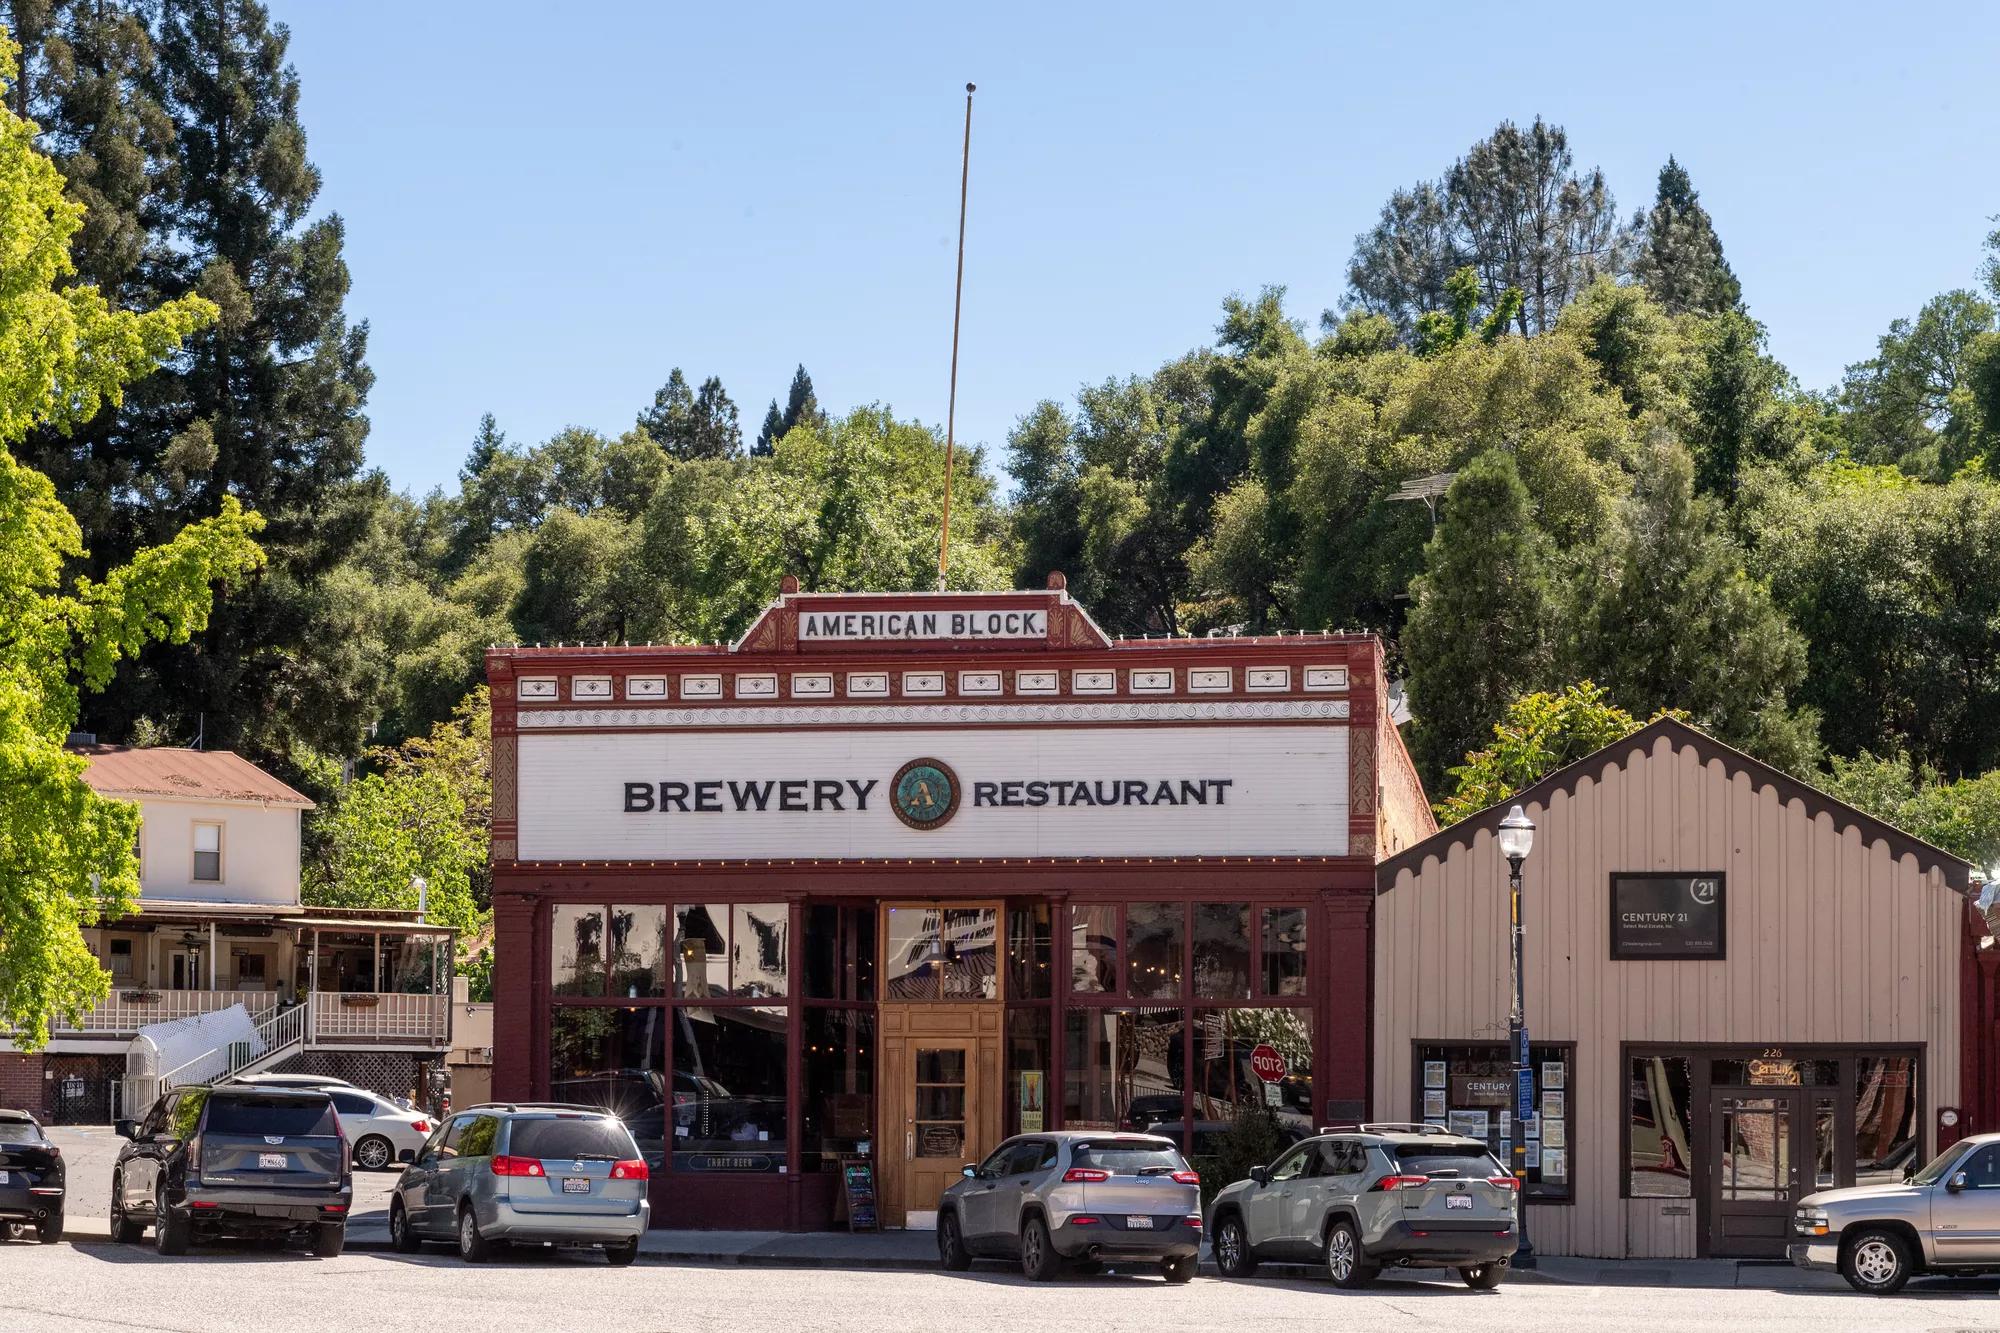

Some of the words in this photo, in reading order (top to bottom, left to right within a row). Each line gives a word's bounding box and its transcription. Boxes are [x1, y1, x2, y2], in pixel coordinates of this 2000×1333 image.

[806, 614, 936, 636] AMERICAN
[951, 612, 1046, 635] BLOCK.
[623, 779, 879, 813] BREWERY
[911, 782, 934, 805] A
[973, 779, 1233, 807] RESTAURANT
[1622, 913, 1675, 922] CENTURY
[1677, 913, 1688, 922] 21
[1763, 1048, 1782, 1058] 226
[1467, 1082, 1512, 1091] CENTURY
[707, 1158, 730, 1167] CRAFT
[733, 1158, 753, 1167] BEER
